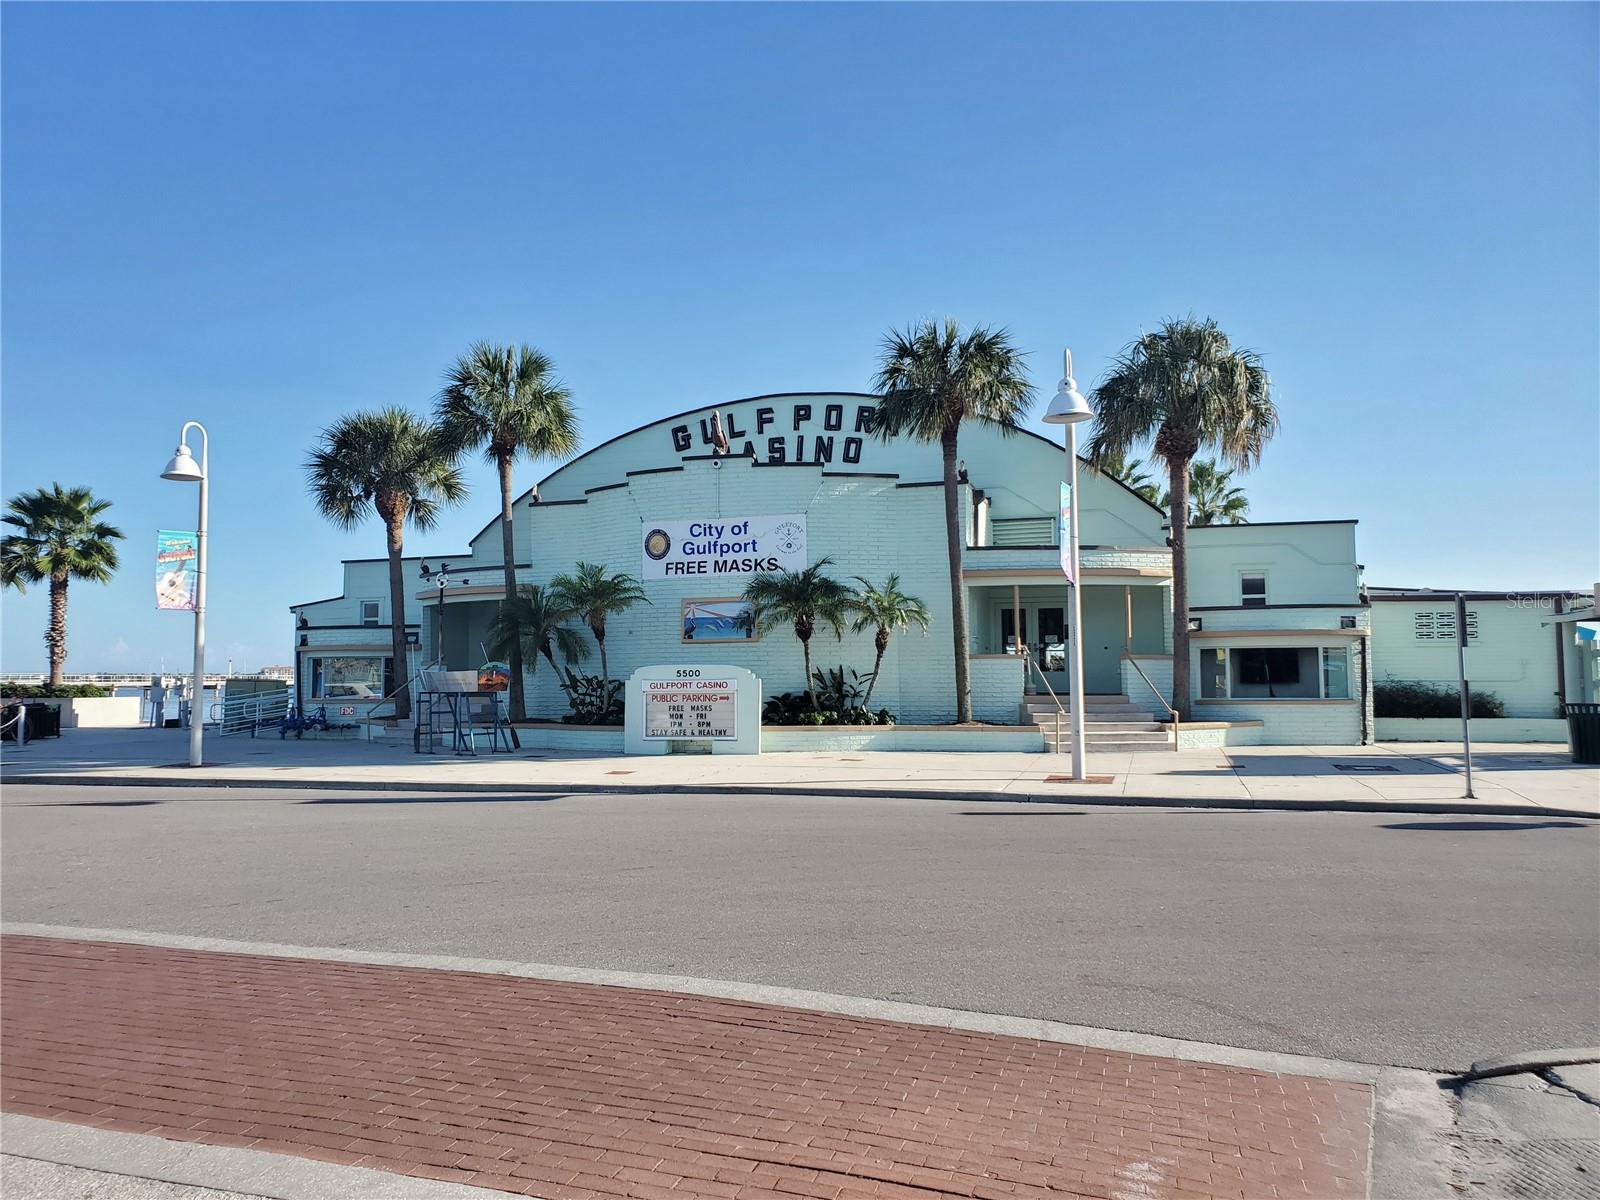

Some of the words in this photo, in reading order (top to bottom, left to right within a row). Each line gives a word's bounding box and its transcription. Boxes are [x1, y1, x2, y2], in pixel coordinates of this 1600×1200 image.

[672, 404, 897, 452] GULFPOR
[713, 436, 863, 464] ASINO
[689, 523, 725, 540] City
[730, 520, 750, 536] of
[682, 539, 758, 557] Gulfport
[665, 560, 708, 576] FREE
[713, 557, 779, 575] MASKS
[676, 669, 701, 678] 5500
[649, 682, 692, 690] GULFPORT
[696, 681, 728, 689] CASINO
[651, 695, 678, 703] PUBLIC
[682, 694, 718, 703] PARKING
[340, 707, 354, 715] FDC
